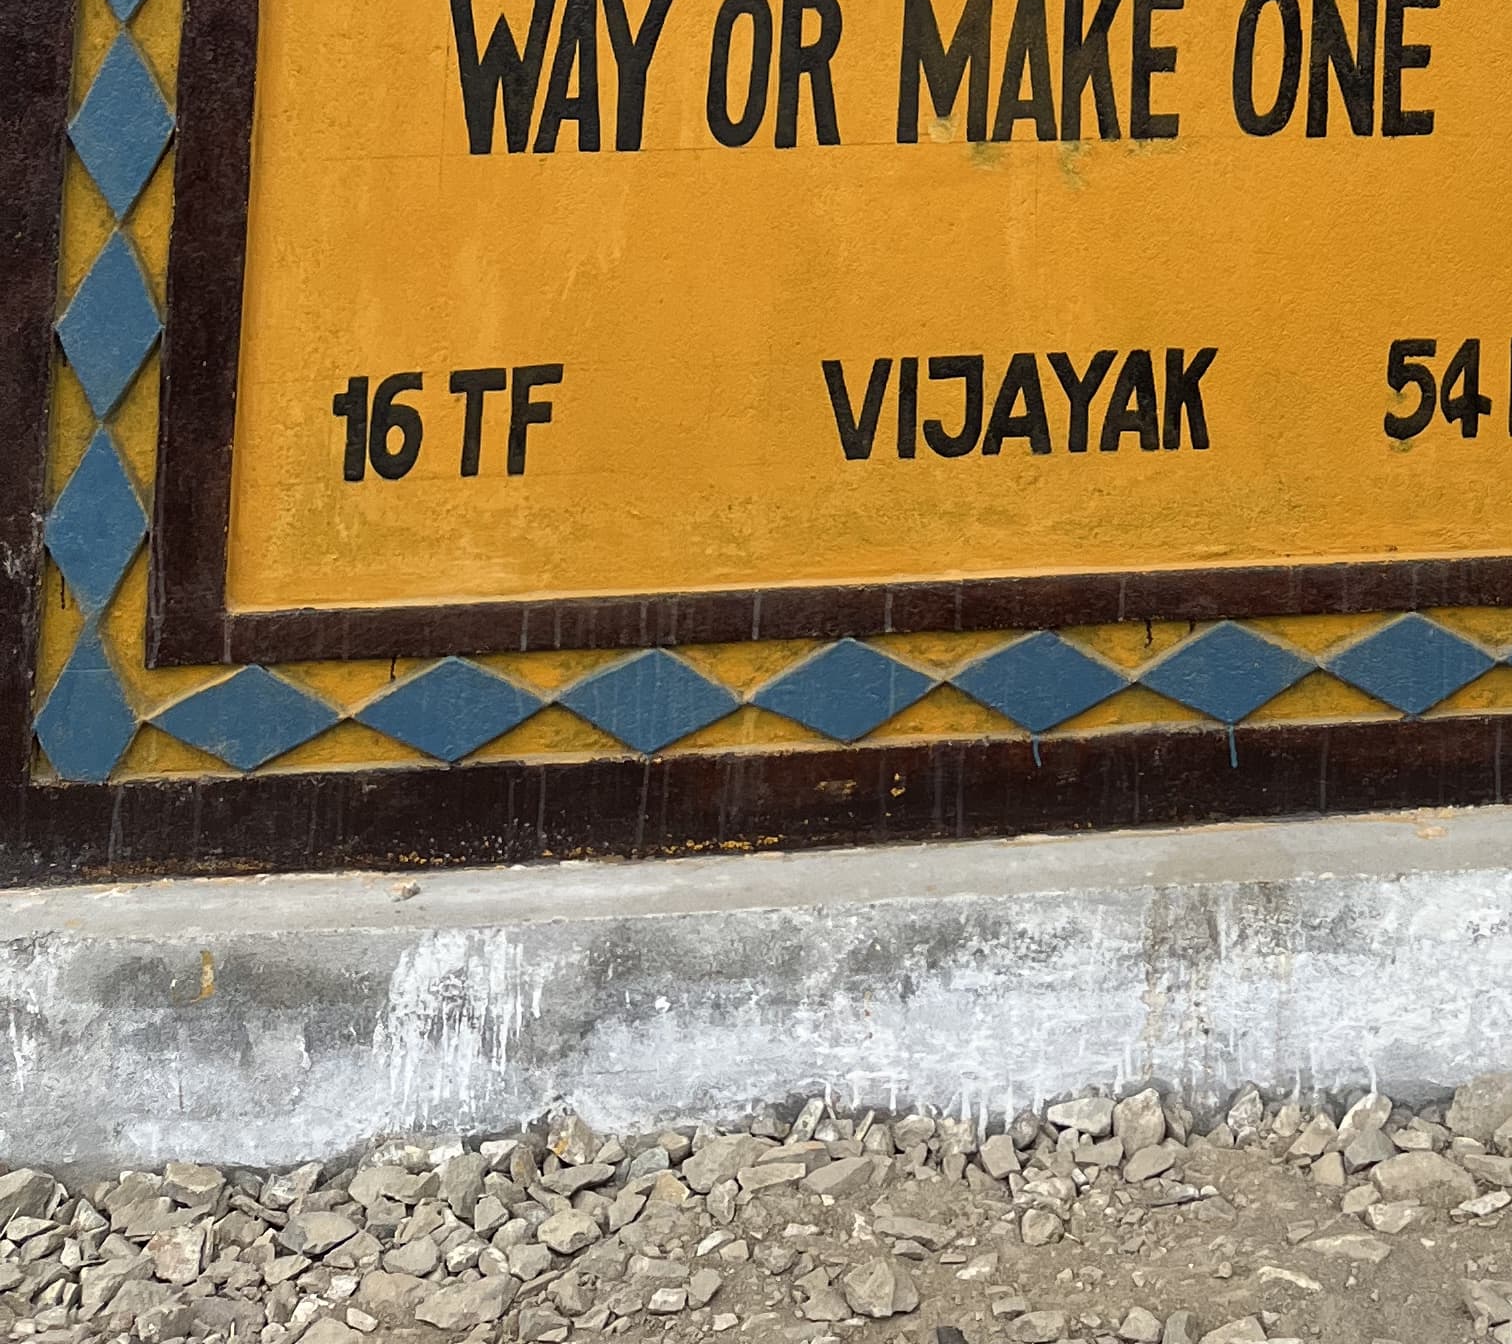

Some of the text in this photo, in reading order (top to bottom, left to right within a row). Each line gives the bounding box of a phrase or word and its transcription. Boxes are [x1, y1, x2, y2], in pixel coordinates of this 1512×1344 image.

[332, 363, 564, 483] 16 TF
[821, 347, 1219, 461] VIJAYAK
